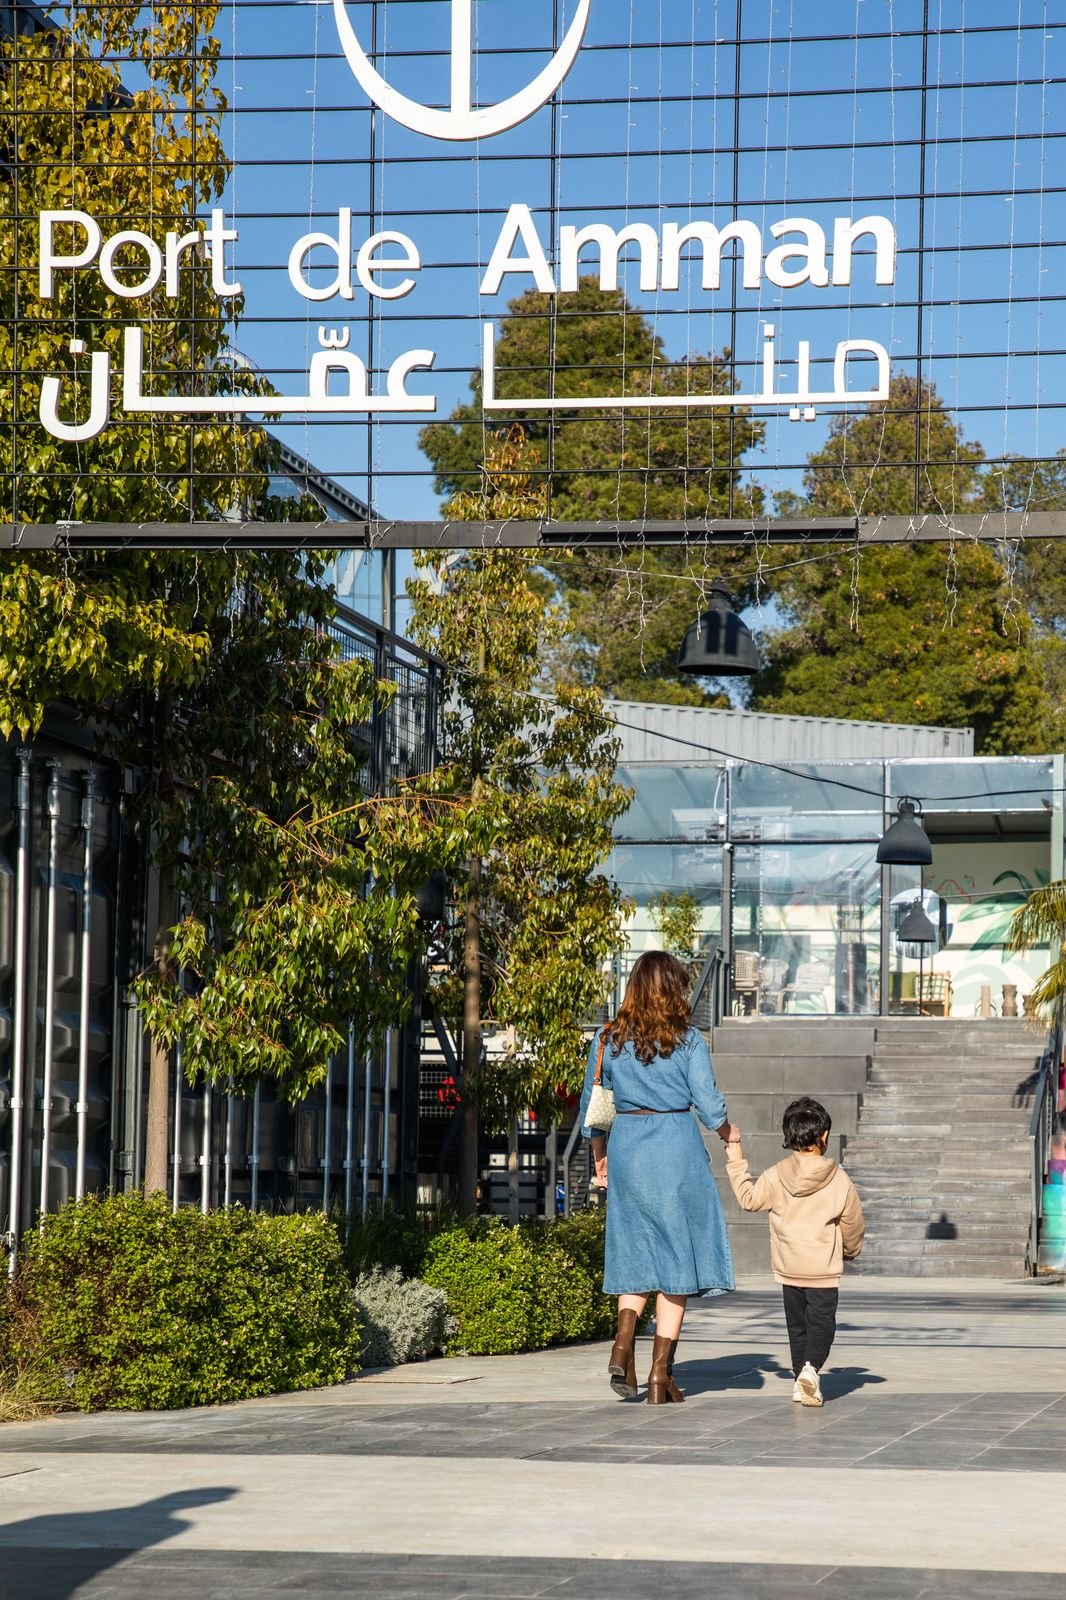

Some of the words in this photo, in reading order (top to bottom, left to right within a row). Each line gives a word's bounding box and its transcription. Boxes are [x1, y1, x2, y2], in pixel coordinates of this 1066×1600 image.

[39, 209, 243, 300] Port
[288, 206, 422, 301] de
[479, 203, 895, 296] Amman
[482, 322, 889, 423] مينا
